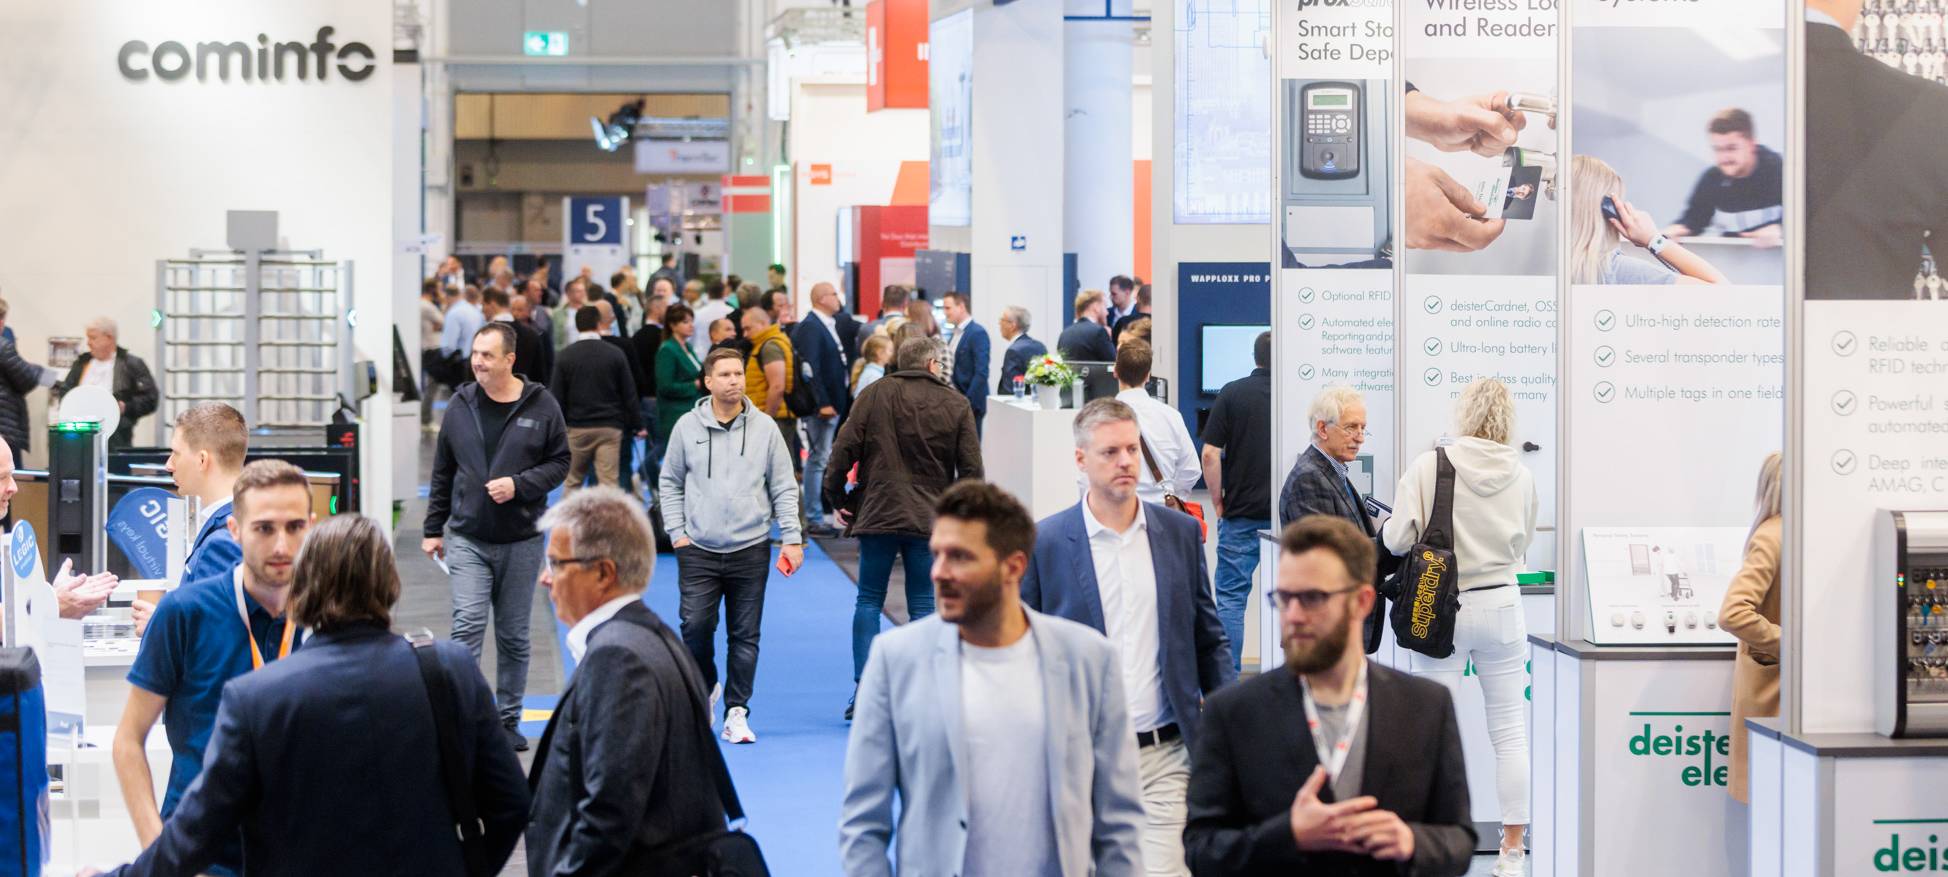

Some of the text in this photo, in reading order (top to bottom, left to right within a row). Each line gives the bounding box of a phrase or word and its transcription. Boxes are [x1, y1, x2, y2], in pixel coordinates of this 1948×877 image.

[1425, 0, 1518, 11] Wireless
[1298, 19, 1357, 38] Smart
[1424, 16, 1557, 37] and Reader
[117, 25, 376, 82] cominfo
[1298, 42, 1393, 65] Safe Dep
[583, 203, 607, 242] 5
[1190, 274, 1240, 283] WAPPLOXX
[1243, 274, 1261, 283] PRO
[1321, 290, 1392, 302] Optional RFID
[1321, 317, 1375, 328] Automated
[1450, 316, 1472, 328] and
[1475, 315, 1509, 328] online
[1513, 315, 1542, 328] radio
[1624, 313, 1782, 331] Ultra-high detection rate
[1321, 331, 1365, 343] Reporting
[1365, 331, 1384, 341] and
[1868, 334, 1928, 352] Reliable
[1321, 344, 1363, 355] software
[1450, 341, 1506, 356] Ultra-long
[1509, 341, 1548, 355] battery
[1624, 348, 1785, 367] Several transponder types
[1868, 358, 1905, 374] RFID
[1321, 367, 1349, 379] Many
[1450, 371, 1473, 384] Best
[1520, 371, 1559, 387] quality
[1513, 391, 1548, 401] rmany
[1624, 384, 1785, 403] Multiple tags in one field
[1868, 394, 1933, 411] Powerful
[1868, 454, 1911, 473] Deep
[1867, 476, 1927, 494] AMAG,
[13, 533, 35, 566] LEGIC
